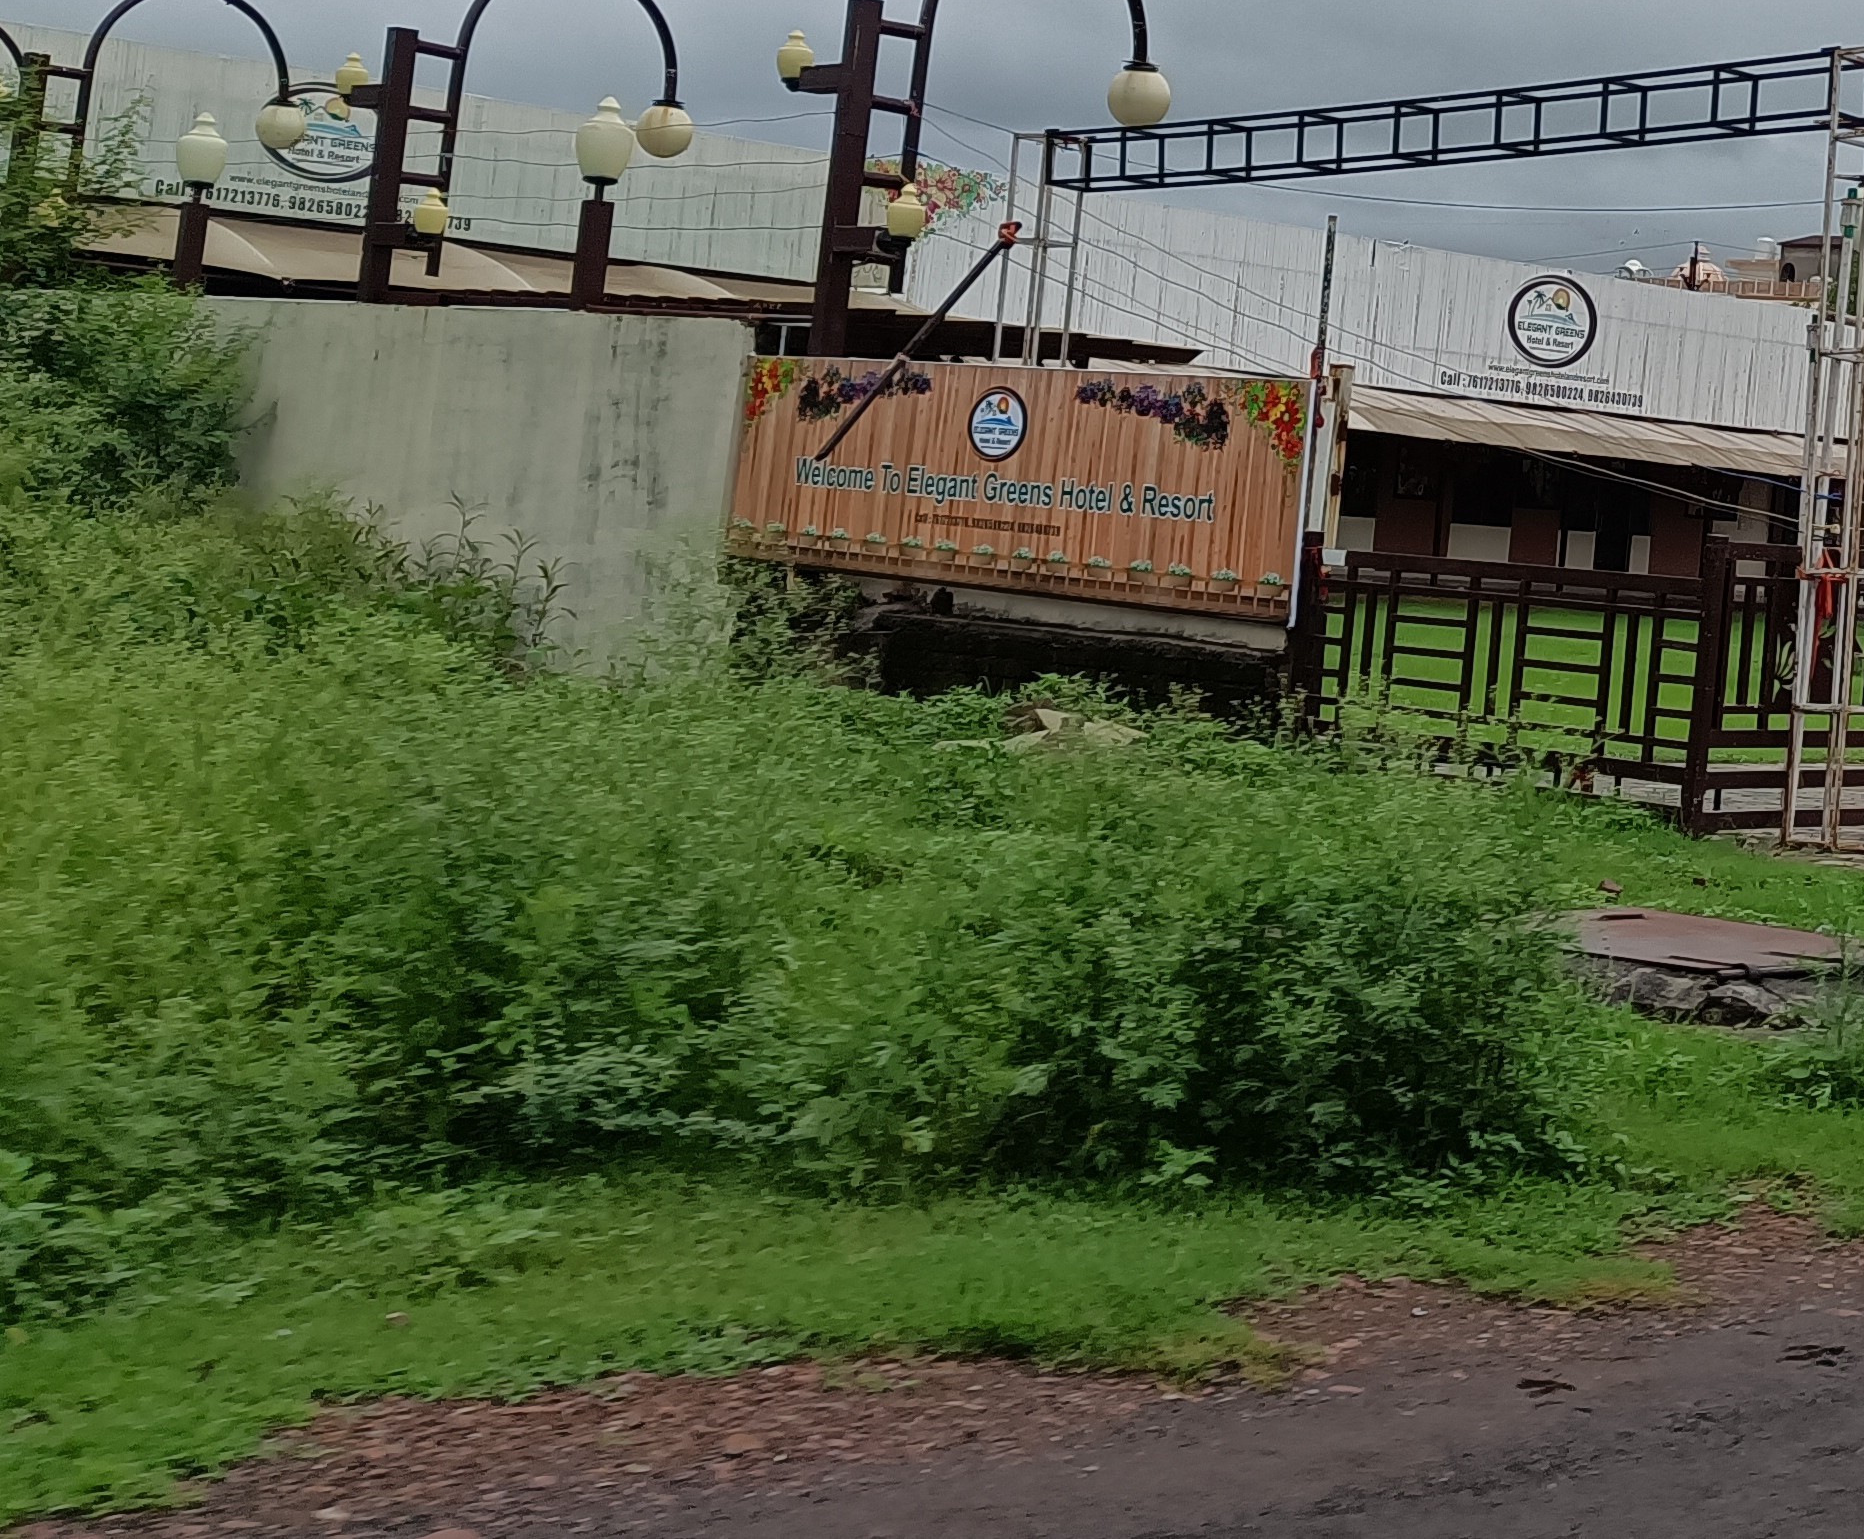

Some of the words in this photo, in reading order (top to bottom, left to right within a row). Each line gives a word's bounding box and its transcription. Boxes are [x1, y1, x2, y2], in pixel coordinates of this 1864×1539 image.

[1517, 320, 1553, 336] ELEGANT
[1555, 325, 1586, 340] GREENS
[1440, 370, 1461, 387] Call
[795, 457, 875, 491] Welcome
[881, 463, 900, 493] To
[906, 465, 978, 505] Elegant
[983, 472, 1053, 508] Greens
[1059, 478, 1115, 512] Hotel
[1119, 482, 1135, 515] &
[1141, 484, 1215, 522] Resort
